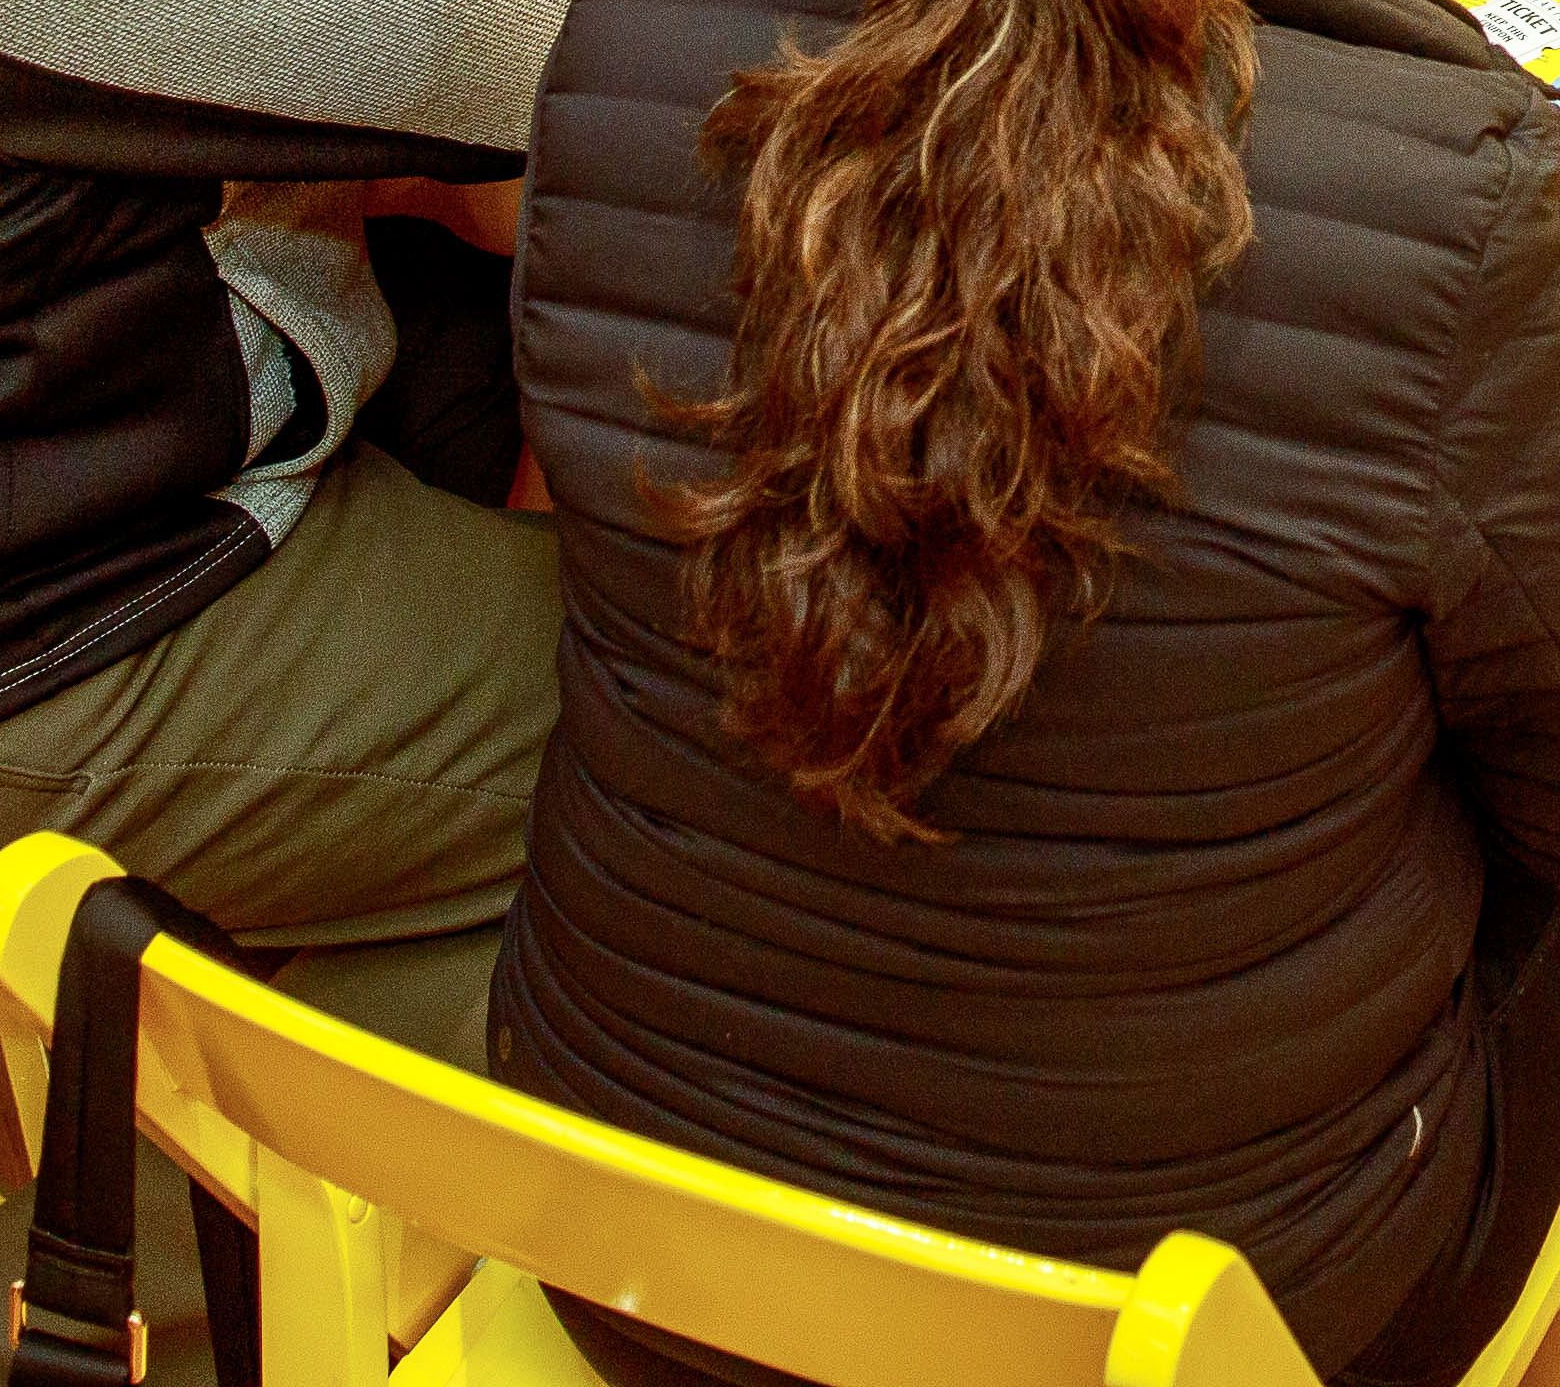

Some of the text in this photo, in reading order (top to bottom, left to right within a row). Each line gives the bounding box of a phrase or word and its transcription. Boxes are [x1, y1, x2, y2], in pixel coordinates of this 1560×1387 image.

[1480, 19, 1512, 43] COUPON
[1484, 12, 1527, 42] KEEP THIS
